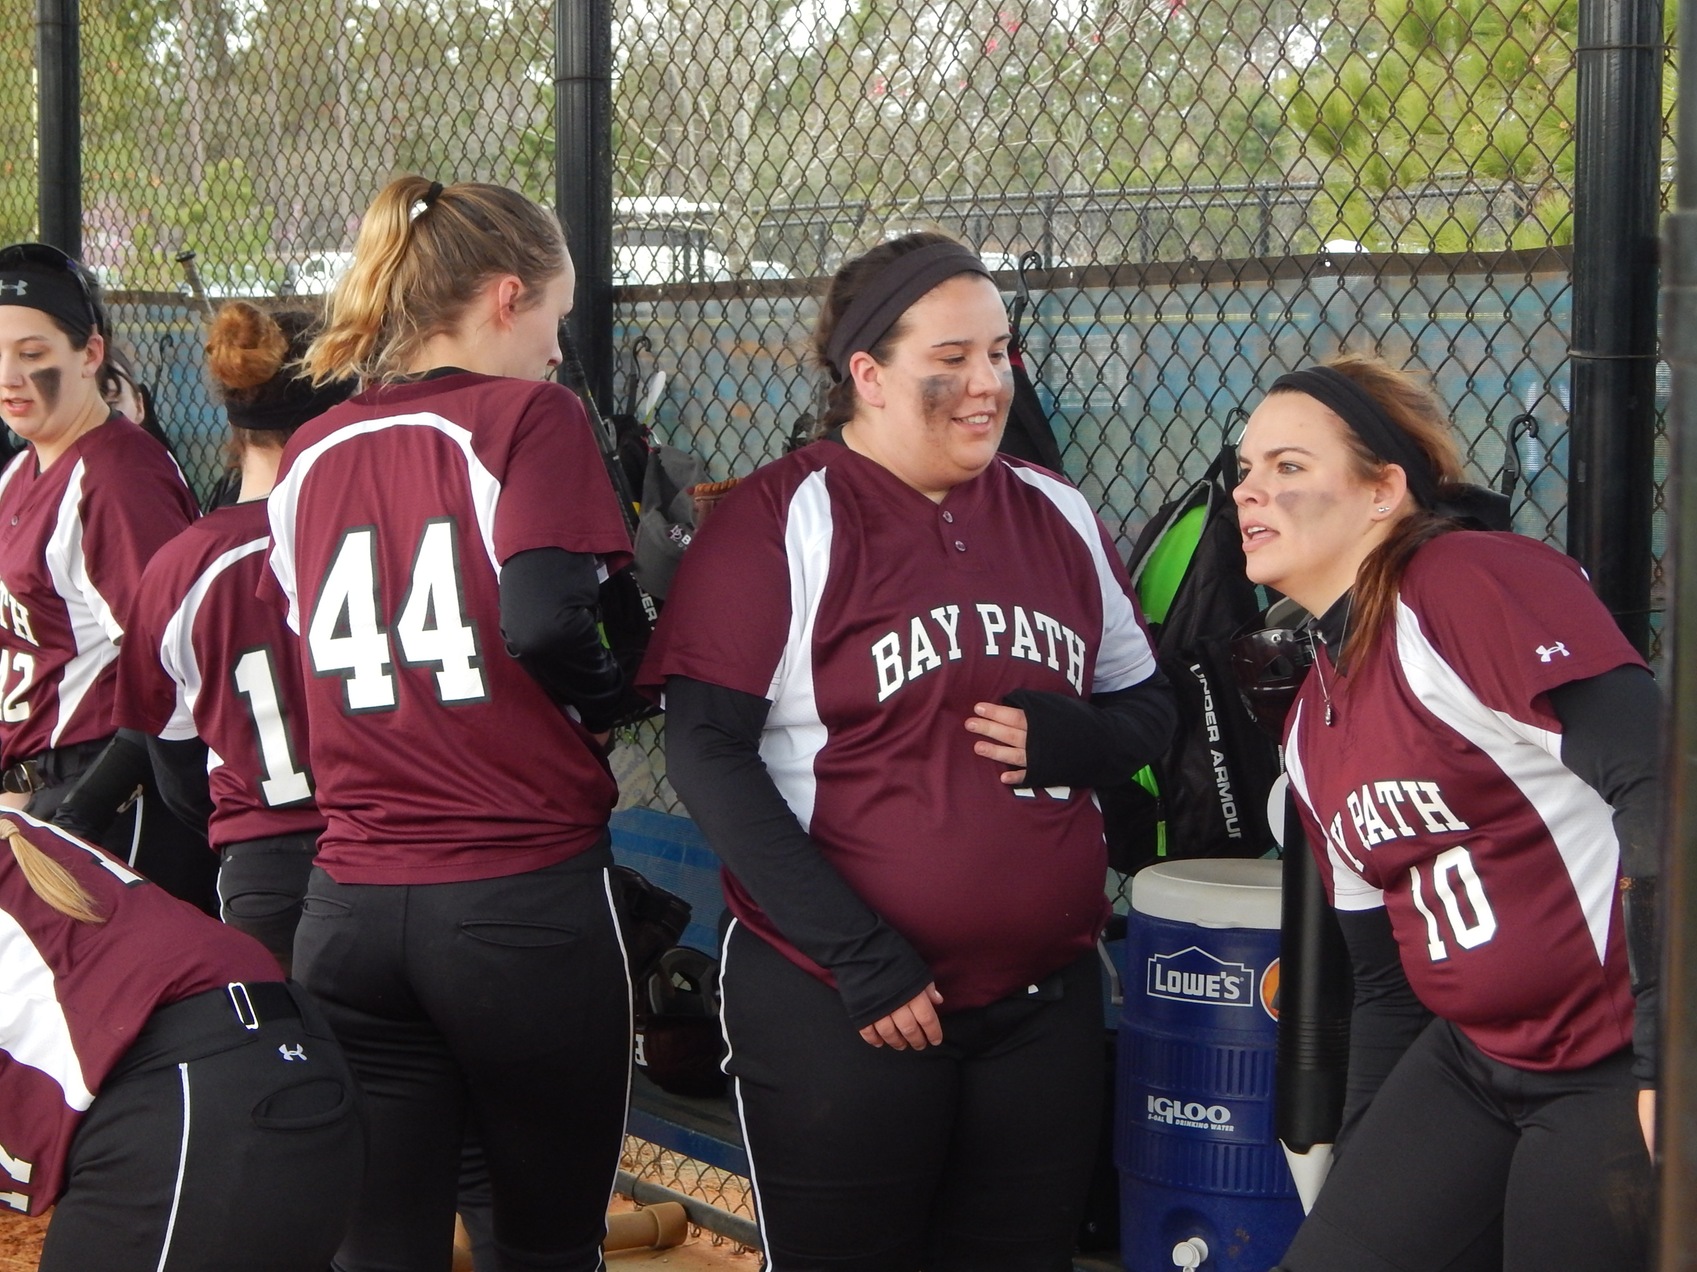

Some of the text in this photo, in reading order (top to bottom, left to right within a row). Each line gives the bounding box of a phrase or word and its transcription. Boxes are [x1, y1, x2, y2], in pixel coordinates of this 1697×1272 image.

[308, 521, 486, 711] 44
[871, 603, 1086, 703] BAY PATH
[1189, 663, 1220, 743] UNDER
[1346, 780, 1471, 851] PATH
[1409, 845, 1497, 961] 10
[1155, 963, 1241, 1000] LOWE'S
[1147, 1095, 1232, 1125] IGLOO
[1174, 1119, 1210, 1130] DRINKING
[1210, 1123, 1235, 1132] WATER
